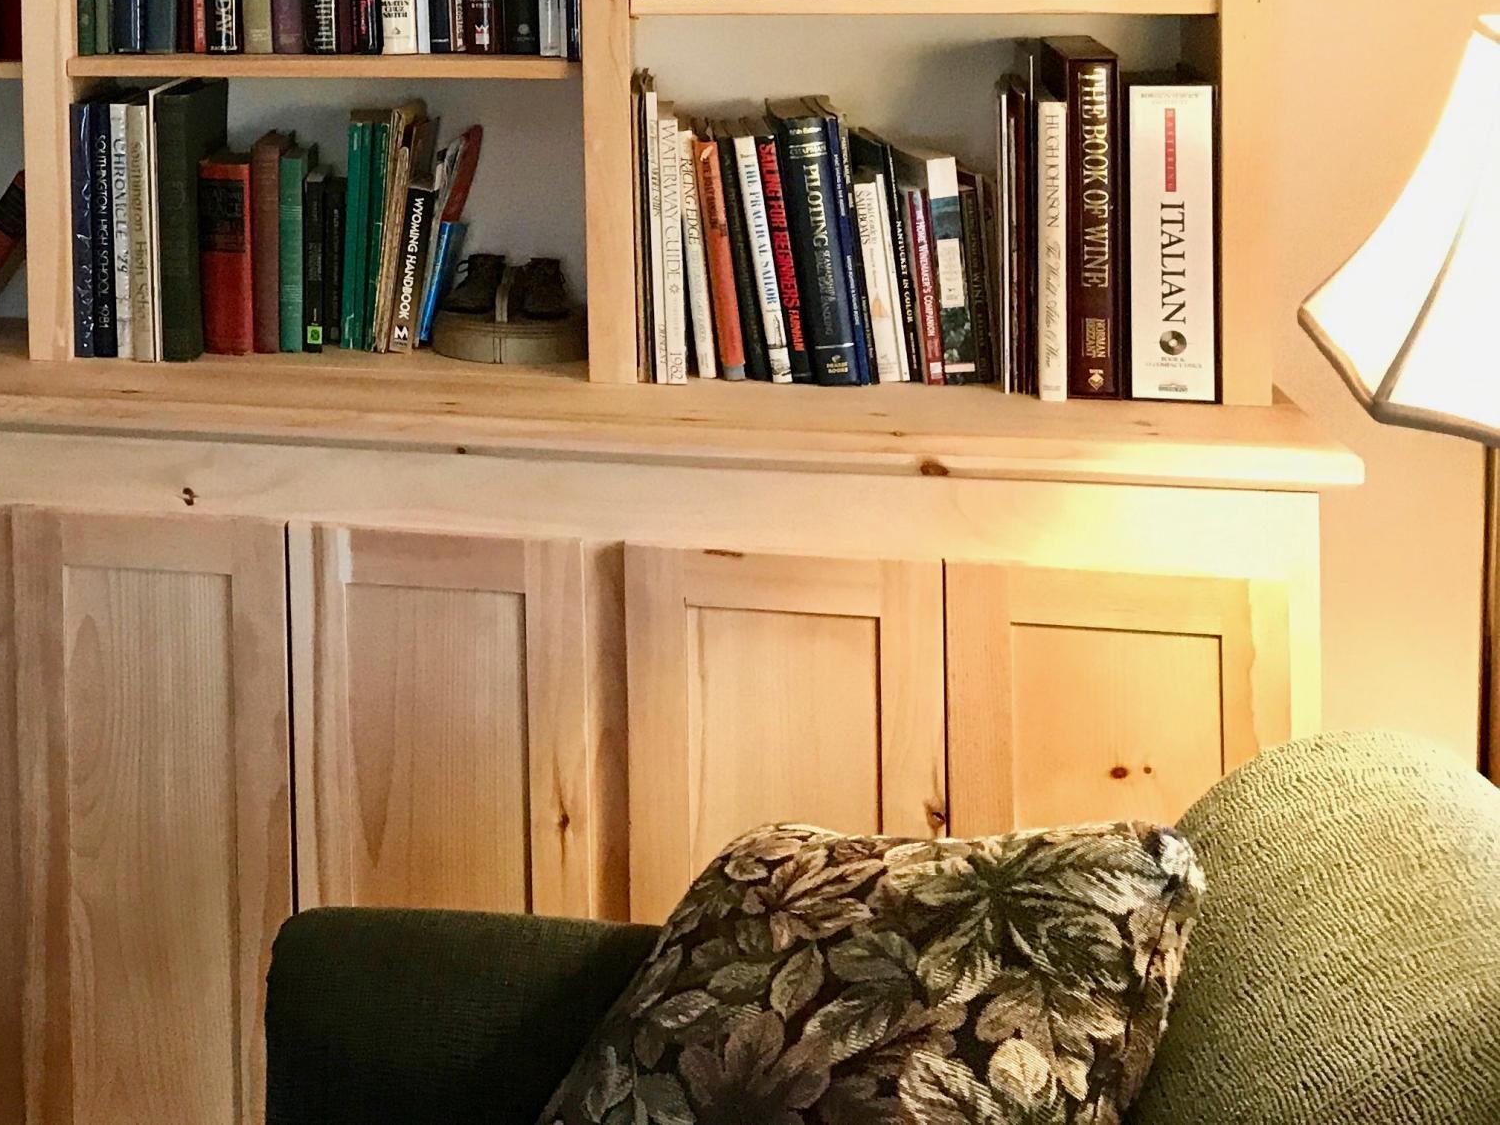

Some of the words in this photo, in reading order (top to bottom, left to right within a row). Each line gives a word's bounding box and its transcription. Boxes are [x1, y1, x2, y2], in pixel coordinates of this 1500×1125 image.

[1078, 67, 1108, 119] THE
[1045, 115, 1060, 158] HUGH
[1082, 123, 1109, 185] BOOK
[113, 138, 129, 239] CHRONICLE
[661, 124, 678, 223] WATERWAY
[679, 157, 698, 207] RACING
[744, 165, 758, 187] THE
[758, 143, 783, 197] SAILING
[767, 200, 788, 227] FOR
[803, 162, 829, 248] PILOTING
[854, 189, 870, 246] SAILBOATS
[1046, 163, 1061, 228] JOHNSON
[1082, 189, 1110, 219] OF
[99, 218, 109, 246] HIGH
[407, 197, 425, 254] WYOMING
[685, 208, 702, 246] EDGE
[749, 190, 769, 257] PRACTICAL
[896, 220, 908, 275] NANTUCKET
[916, 221, 928, 244] HOME
[98, 250, 109, 296] SCHOOL
[134, 241, 148, 276] High
[665, 226, 682, 280] GUIDE
[773, 231, 800, 308] BEGINNERS
[918, 245, 933, 294] WINEMAKER'S
[1081, 223, 1109, 288] WINE
[1160, 200, 1187, 325] ITALIAN
[398, 255, 417, 320] HANDBOOK
[761, 261, 778, 305] SAILOR
[903, 279, 910, 289] IN
[904, 291, 914, 323] COLOR
[923, 295, 936, 337] COMPANION
[1095, 319, 1107, 358] NORMAN
[669, 351, 684, 380] 1982
